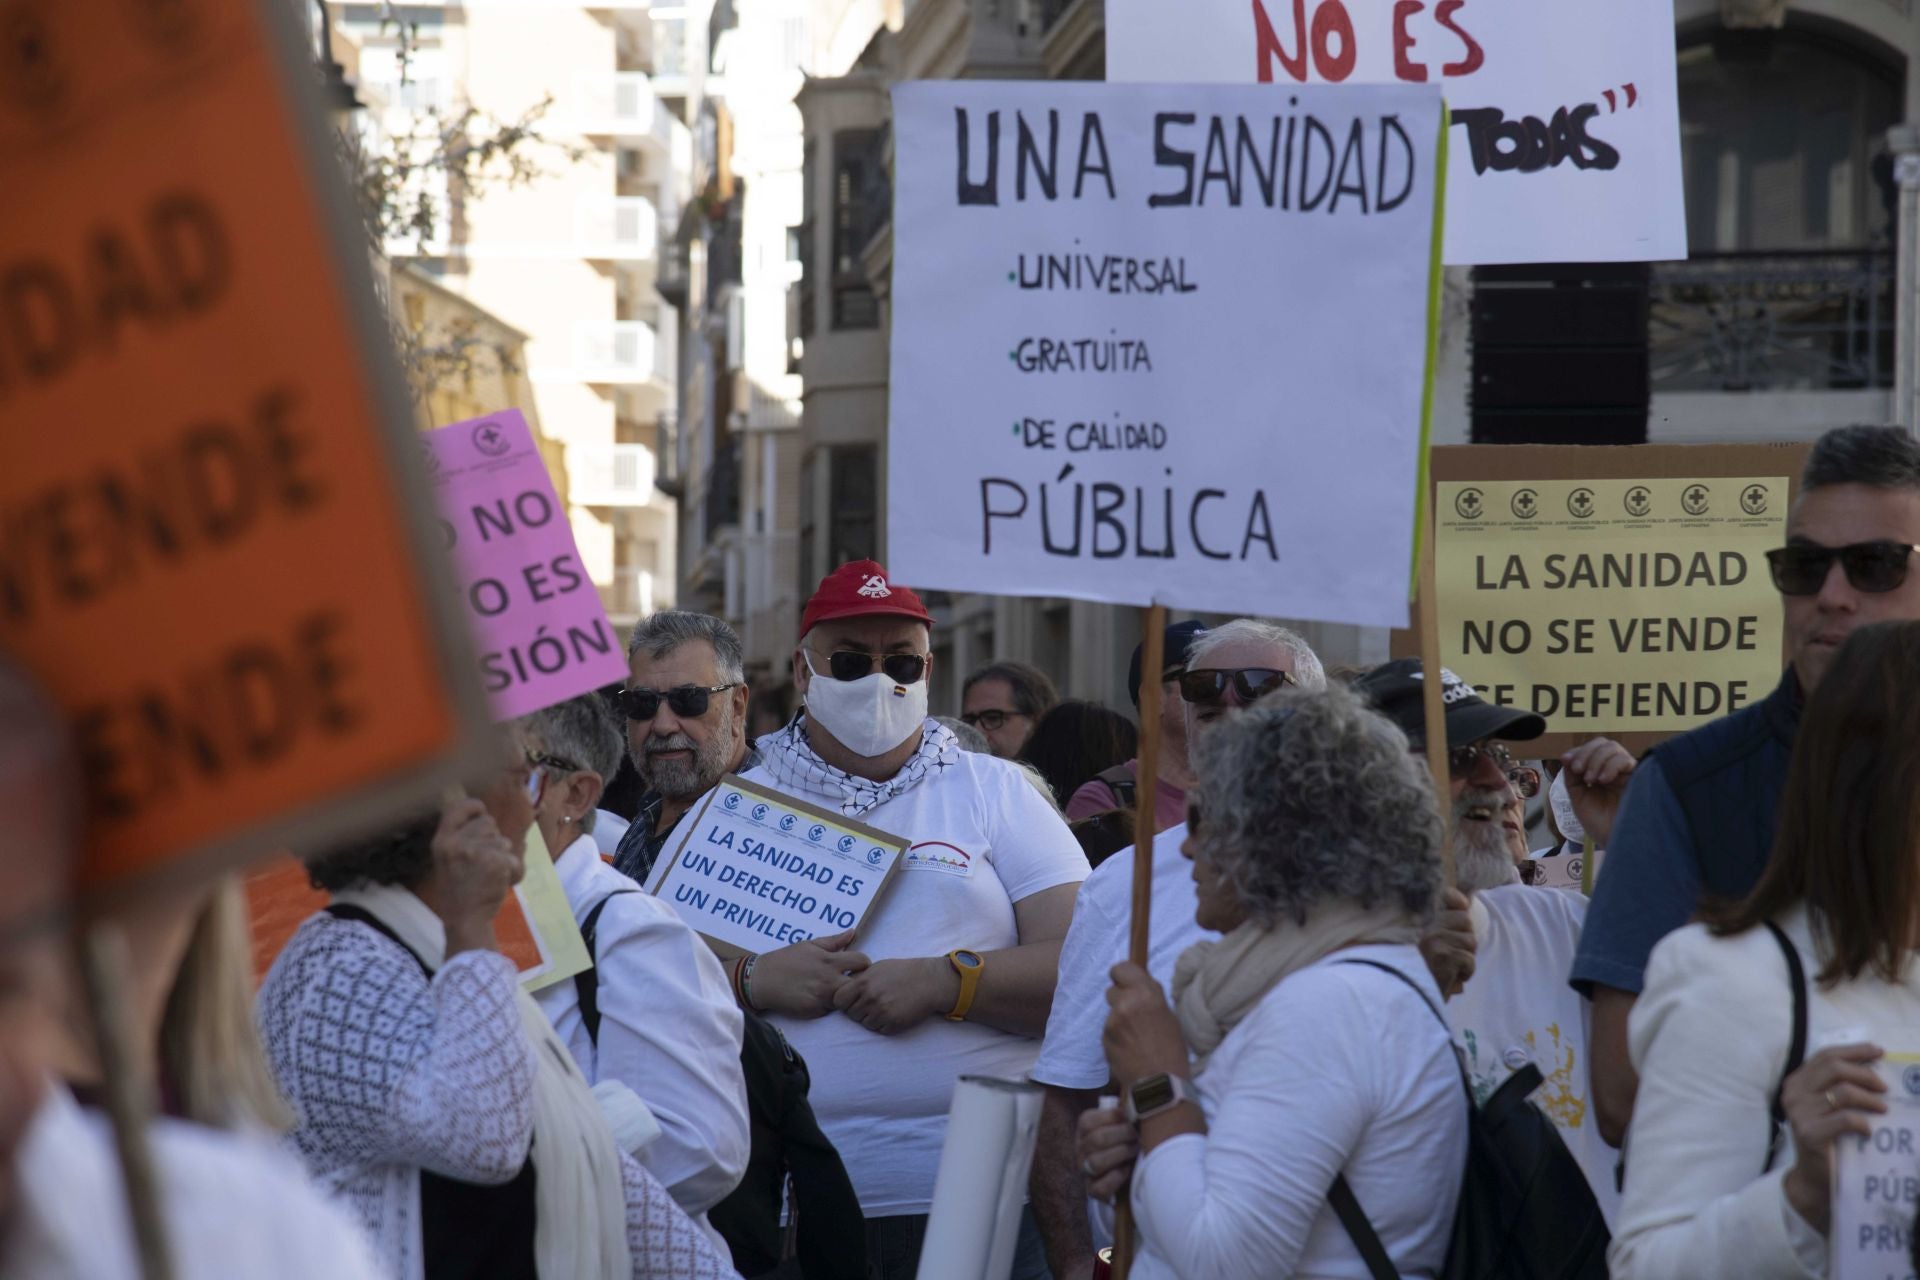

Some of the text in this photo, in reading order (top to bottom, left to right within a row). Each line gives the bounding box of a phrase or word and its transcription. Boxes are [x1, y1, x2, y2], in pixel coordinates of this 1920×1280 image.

[1252, 0, 1484, 83] NO ES
[955, 96, 1414, 214] UNA SANIDAD
[1023, 417, 1056, 449] DE
[471, 490, 554, 542] NO
[980, 462, 1279, 561] PÚBLICA
[522, 554, 582, 603] ES
[1476, 551, 1748, 590] LA SANIDAD
[1462, 616, 1758, 655] NO SE VENDE
[1532, 681, 1748, 718] DEFIENDE
[707, 825, 735, 850] LA
[737, 837, 834, 885] SANIDAD
[836, 874, 864, 897] ES
[675, 883, 710, 911] UN
[681, 850, 856, 929] UN DERECHO NO
